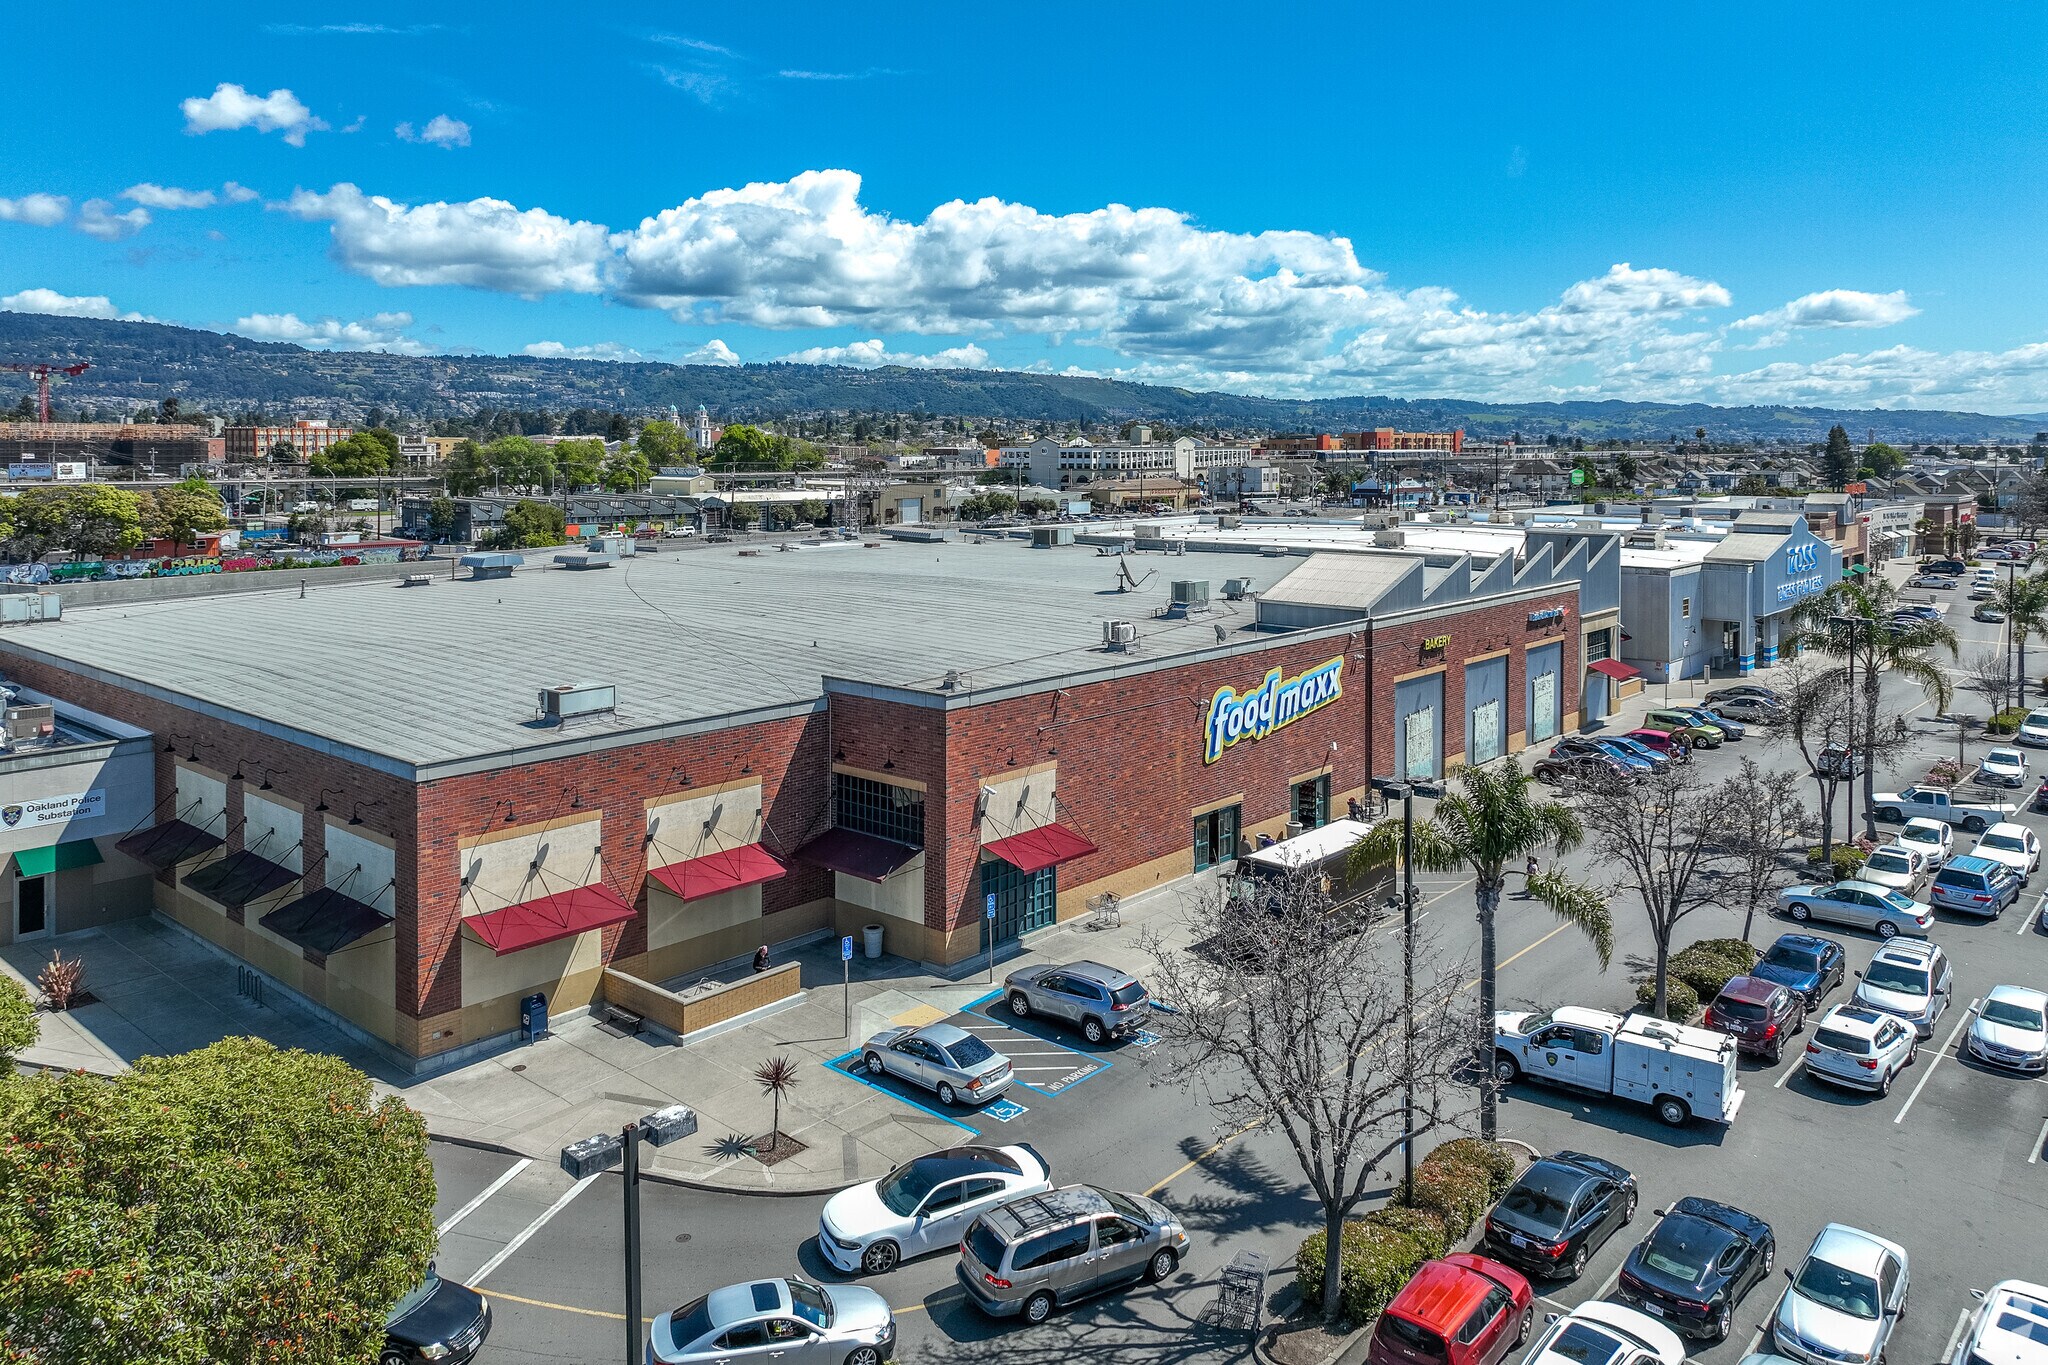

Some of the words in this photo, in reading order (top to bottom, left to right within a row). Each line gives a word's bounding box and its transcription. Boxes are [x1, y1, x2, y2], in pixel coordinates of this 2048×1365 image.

[1786, 543, 1818, 575] ROSS
[1425, 634, 1452, 650] BAKERY
[26, 799, 69, 813] Oakland
[71, 795, 102, 806] Police
[37, 806, 91, 822] Substation
[1047, 1081, 1065, 1092] NO
[1060, 1063, 1098, 1085] PARKING
